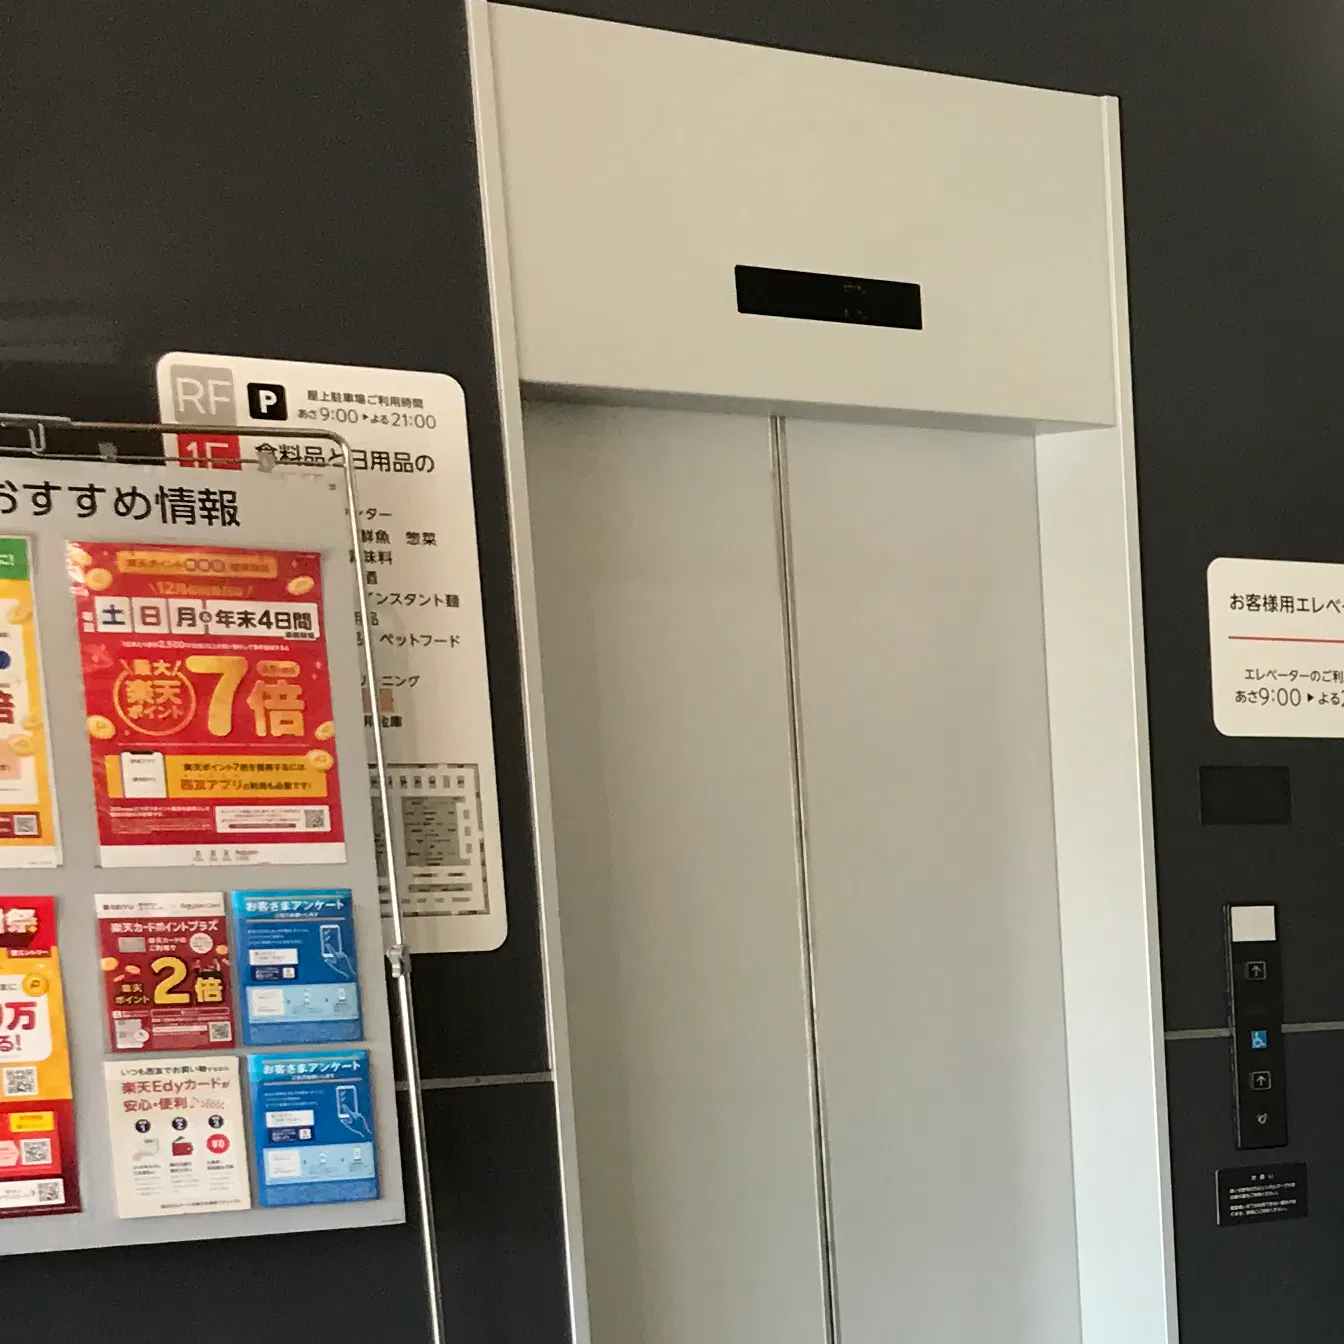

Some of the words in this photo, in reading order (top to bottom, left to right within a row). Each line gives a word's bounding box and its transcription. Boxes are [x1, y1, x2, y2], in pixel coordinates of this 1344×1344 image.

[176, 377, 230, 415] RF
[260, 389, 277, 413] P
[307, 390, 423, 409] 屋上駐車場ご利用時間
[297, 408, 358, 423] あさ9:00
[371, 411, 436, 429] よる21:00
[380, 634, 460, 647] ペットフード
[185, 655, 248, 736] 7
[1235, 688, 1300, 706] あさ9:00
[246, 900, 344, 912] お客さまアンケート
[151, 957, 190, 1004] 2
[195, 977, 223, 1002] 倍
[263, 1061, 361, 1075] お客さまアンケート
